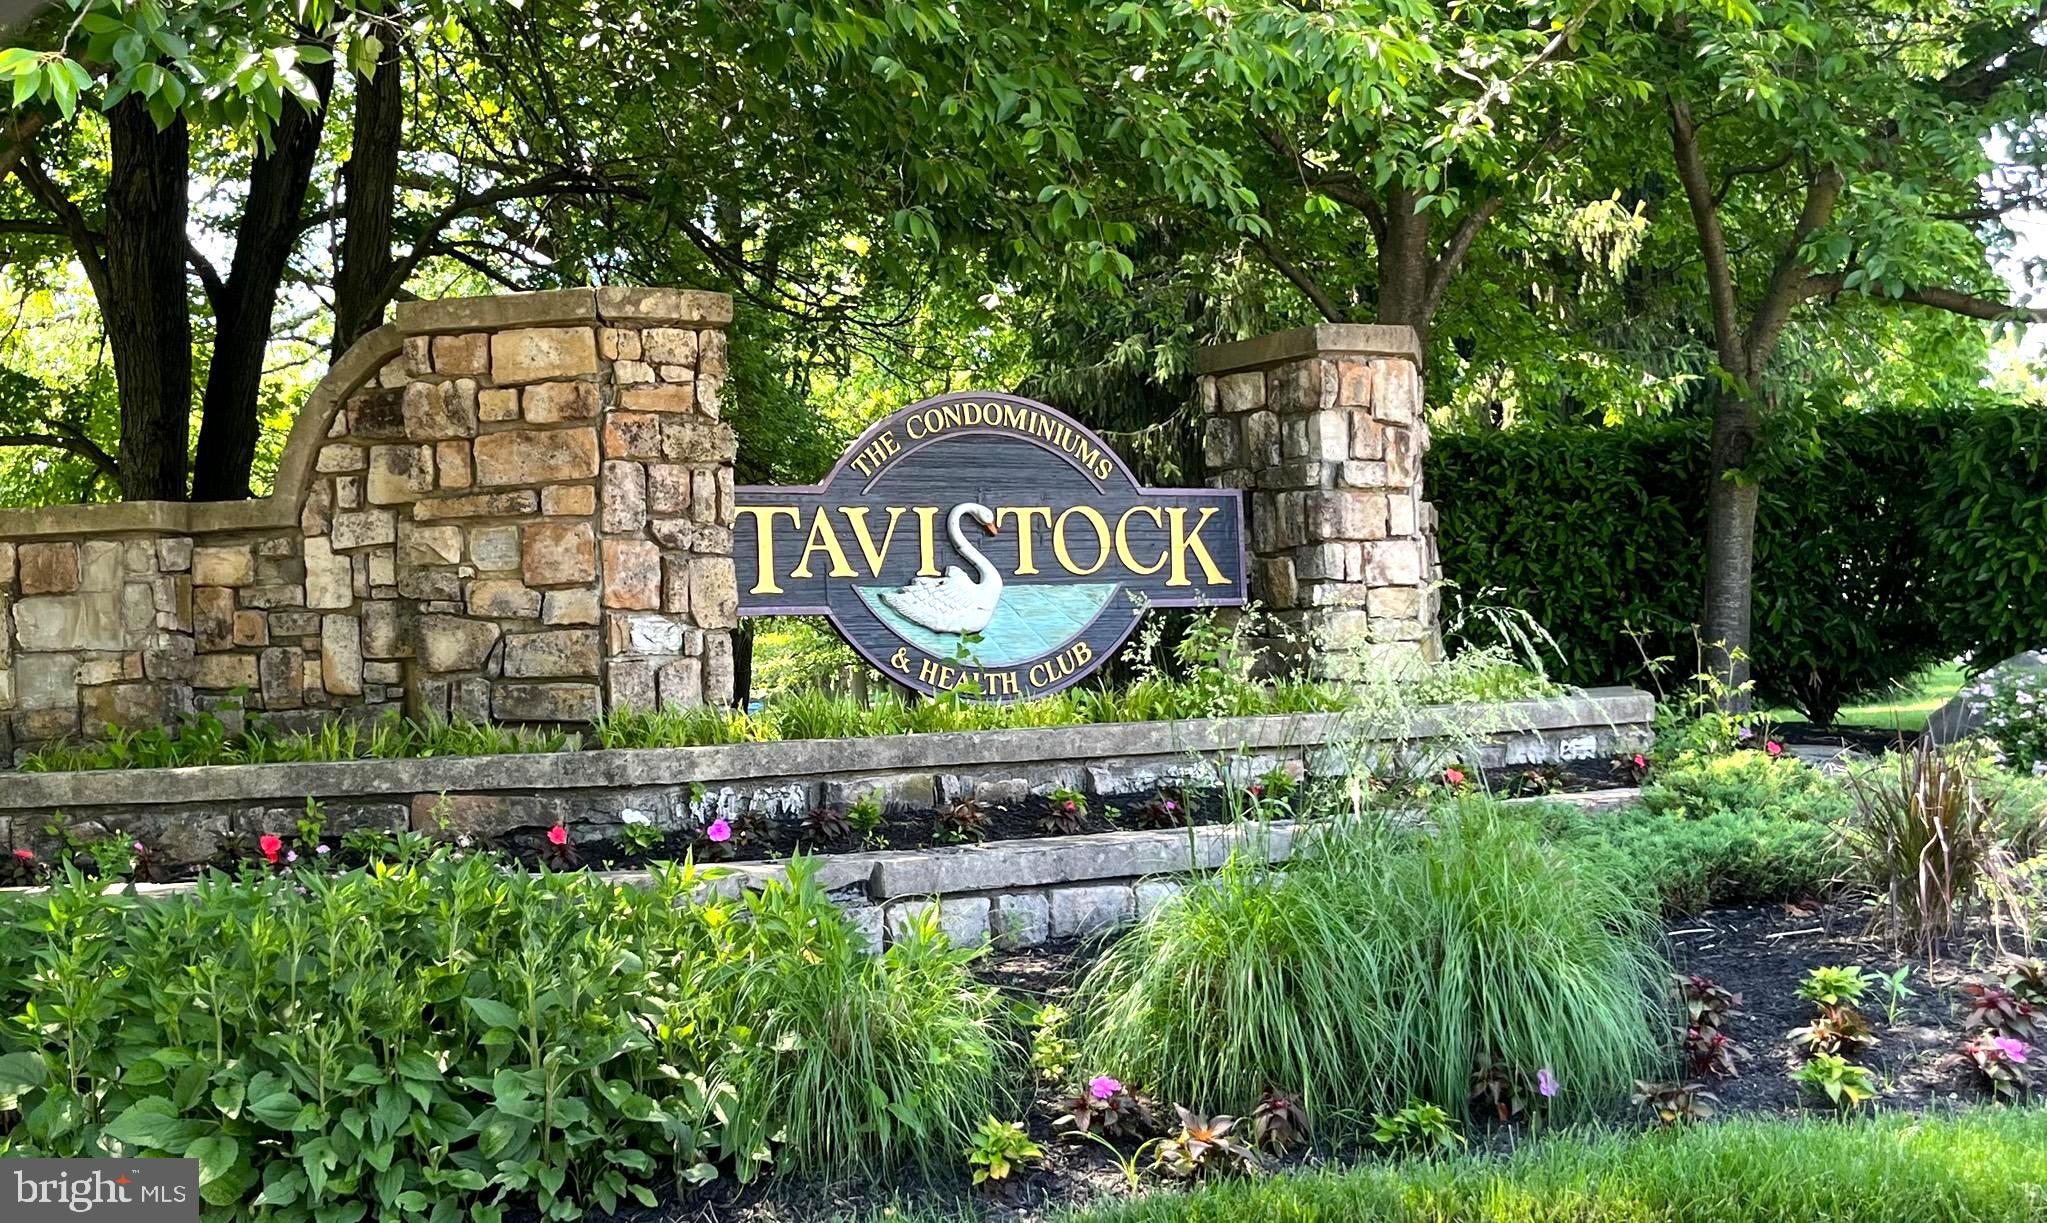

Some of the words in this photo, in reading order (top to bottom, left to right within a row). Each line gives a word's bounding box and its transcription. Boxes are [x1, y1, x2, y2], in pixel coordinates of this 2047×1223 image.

[850, 430, 901, 478] THE
[906, 402, 1114, 481] CONDOMINIUMS
[729, 502, 1232, 595] TAVISTOCK
[890, 646, 911, 674] &
[1029, 641, 1092, 688] CLUB
